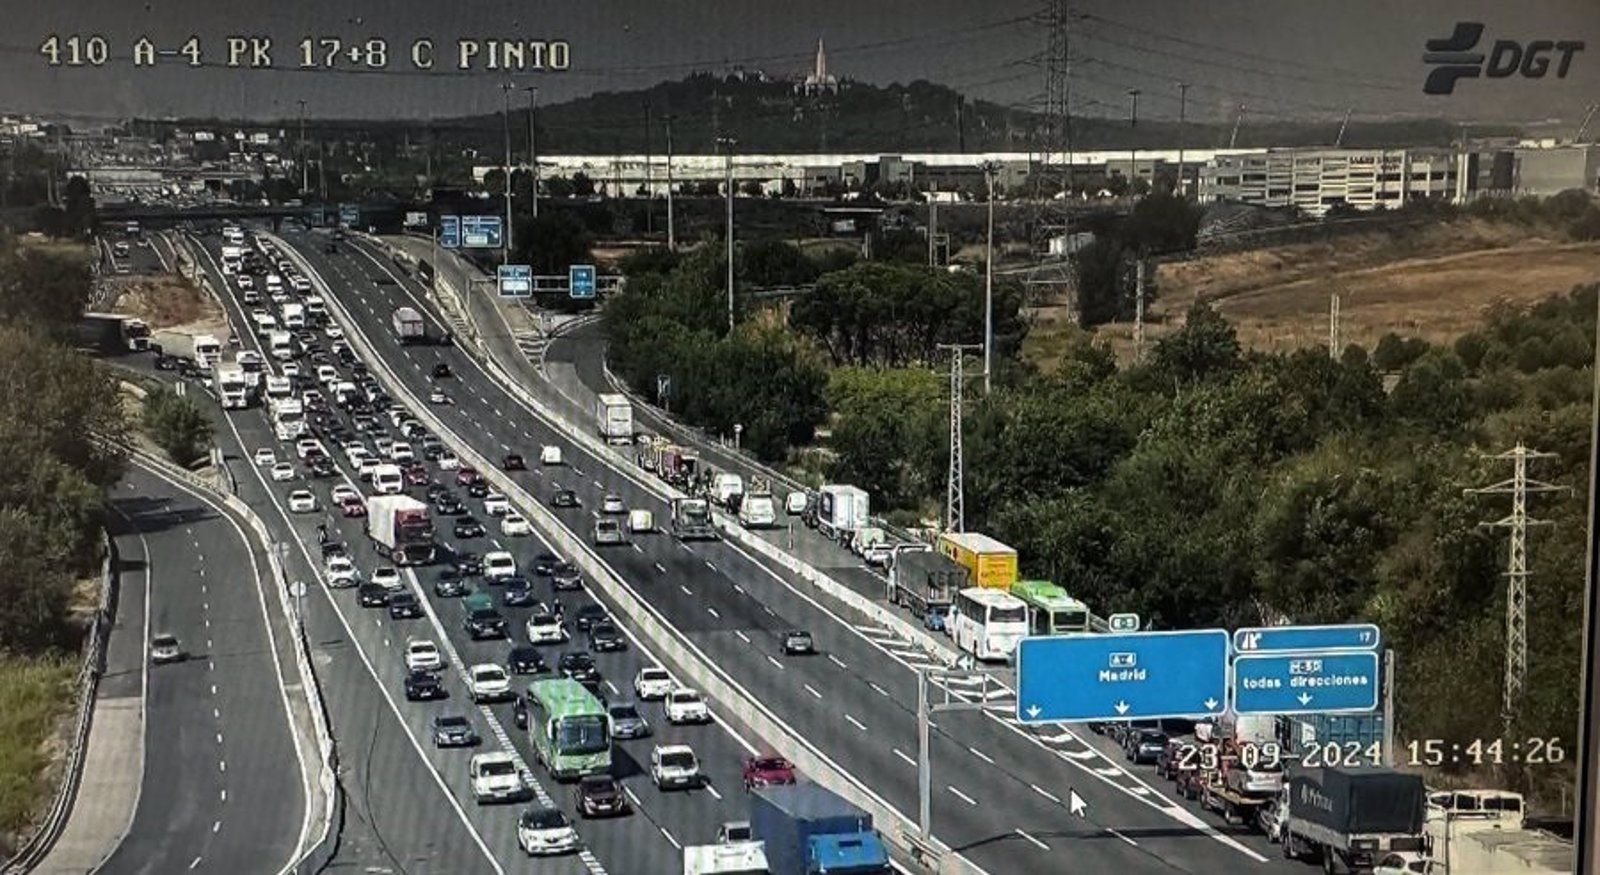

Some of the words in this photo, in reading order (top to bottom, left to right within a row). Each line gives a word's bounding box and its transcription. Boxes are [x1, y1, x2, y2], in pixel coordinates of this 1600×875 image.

[1099, 668, 1147, 682] Madrid
[1243, 677, 1281, 689] todas
[1290, 674, 1368, 687] direcciones
